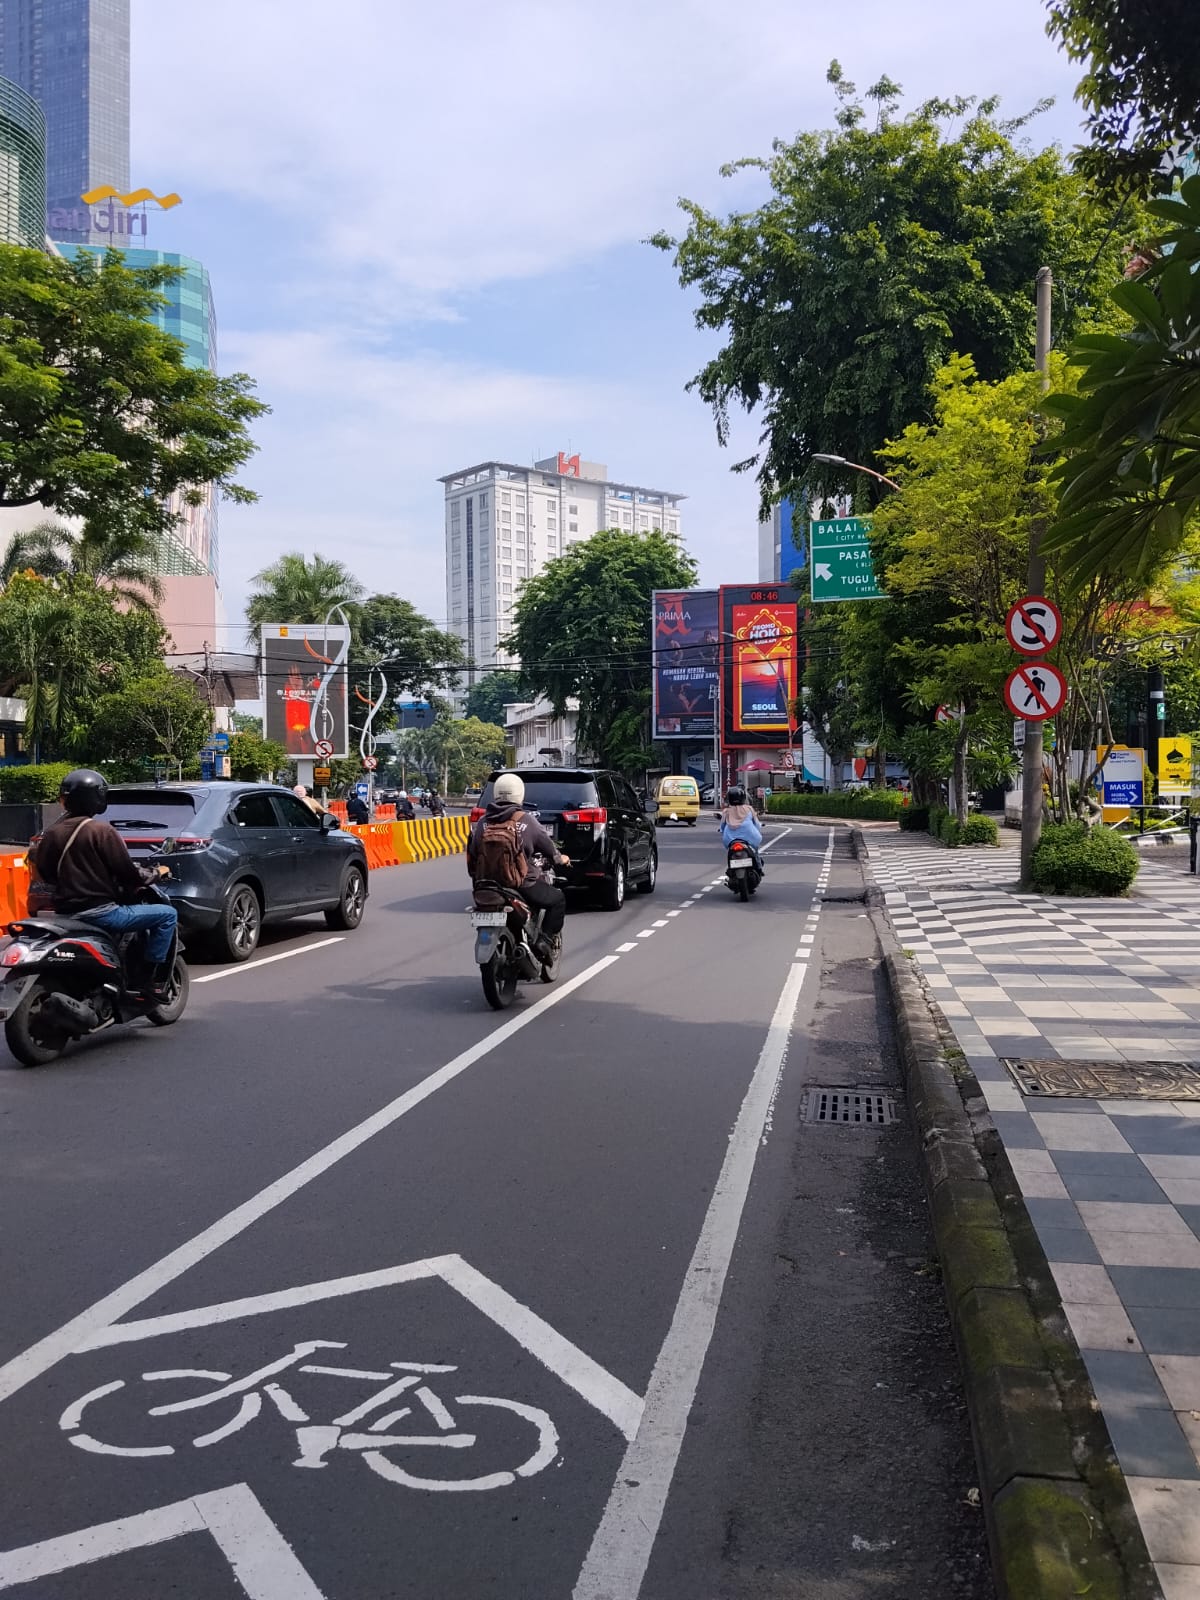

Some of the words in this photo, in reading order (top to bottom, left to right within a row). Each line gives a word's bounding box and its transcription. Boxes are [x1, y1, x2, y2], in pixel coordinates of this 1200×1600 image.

[46, 203, 147, 236] andiri
[818, 522, 857, 534] BALAI
[841, 574, 869, 585] TUGU
[751, 591, 778, 601] 08:46
[658, 611, 692, 621] PRIMA
[752, 623, 776, 631] PROMO
[750, 627, 780, 640] HOKI
[751, 703, 778, 711] SEOUL
